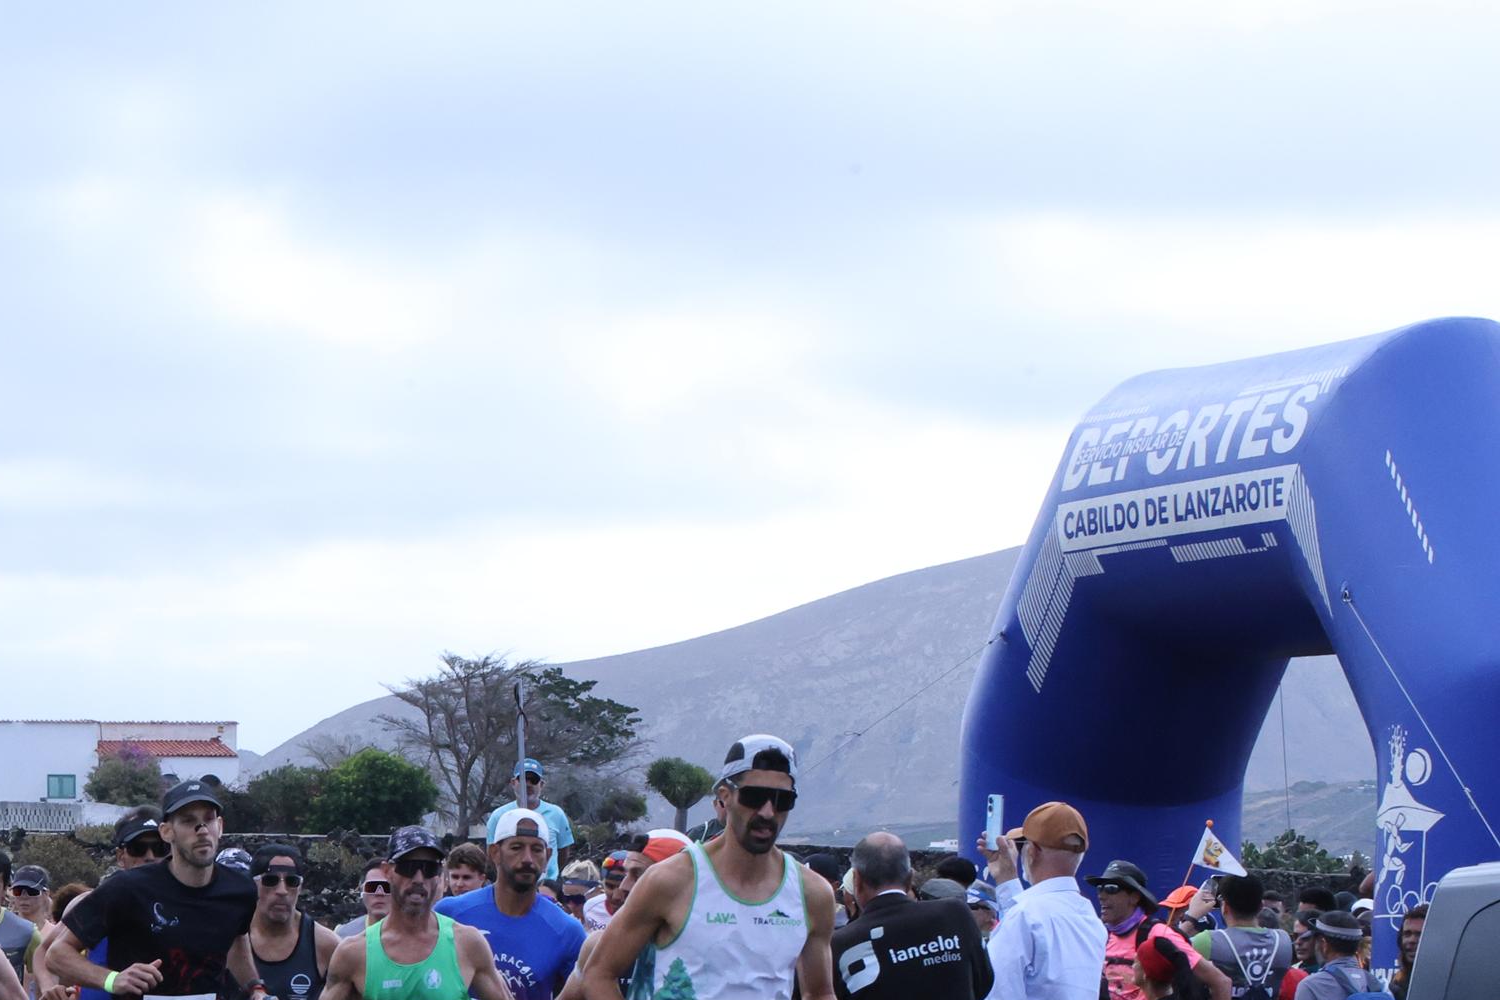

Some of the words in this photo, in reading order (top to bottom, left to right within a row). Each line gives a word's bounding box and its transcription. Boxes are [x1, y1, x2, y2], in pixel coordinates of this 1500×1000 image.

[1061, 384, 1319, 492] DEPORTES
[1064, 500, 1140, 540] CABILDO
[1145, 496, 1169, 527] DE
[1174, 477, 1284, 522] LANZAROTE
[889, 935, 960, 964] lancelot
[923, 951, 962, 967] medios
